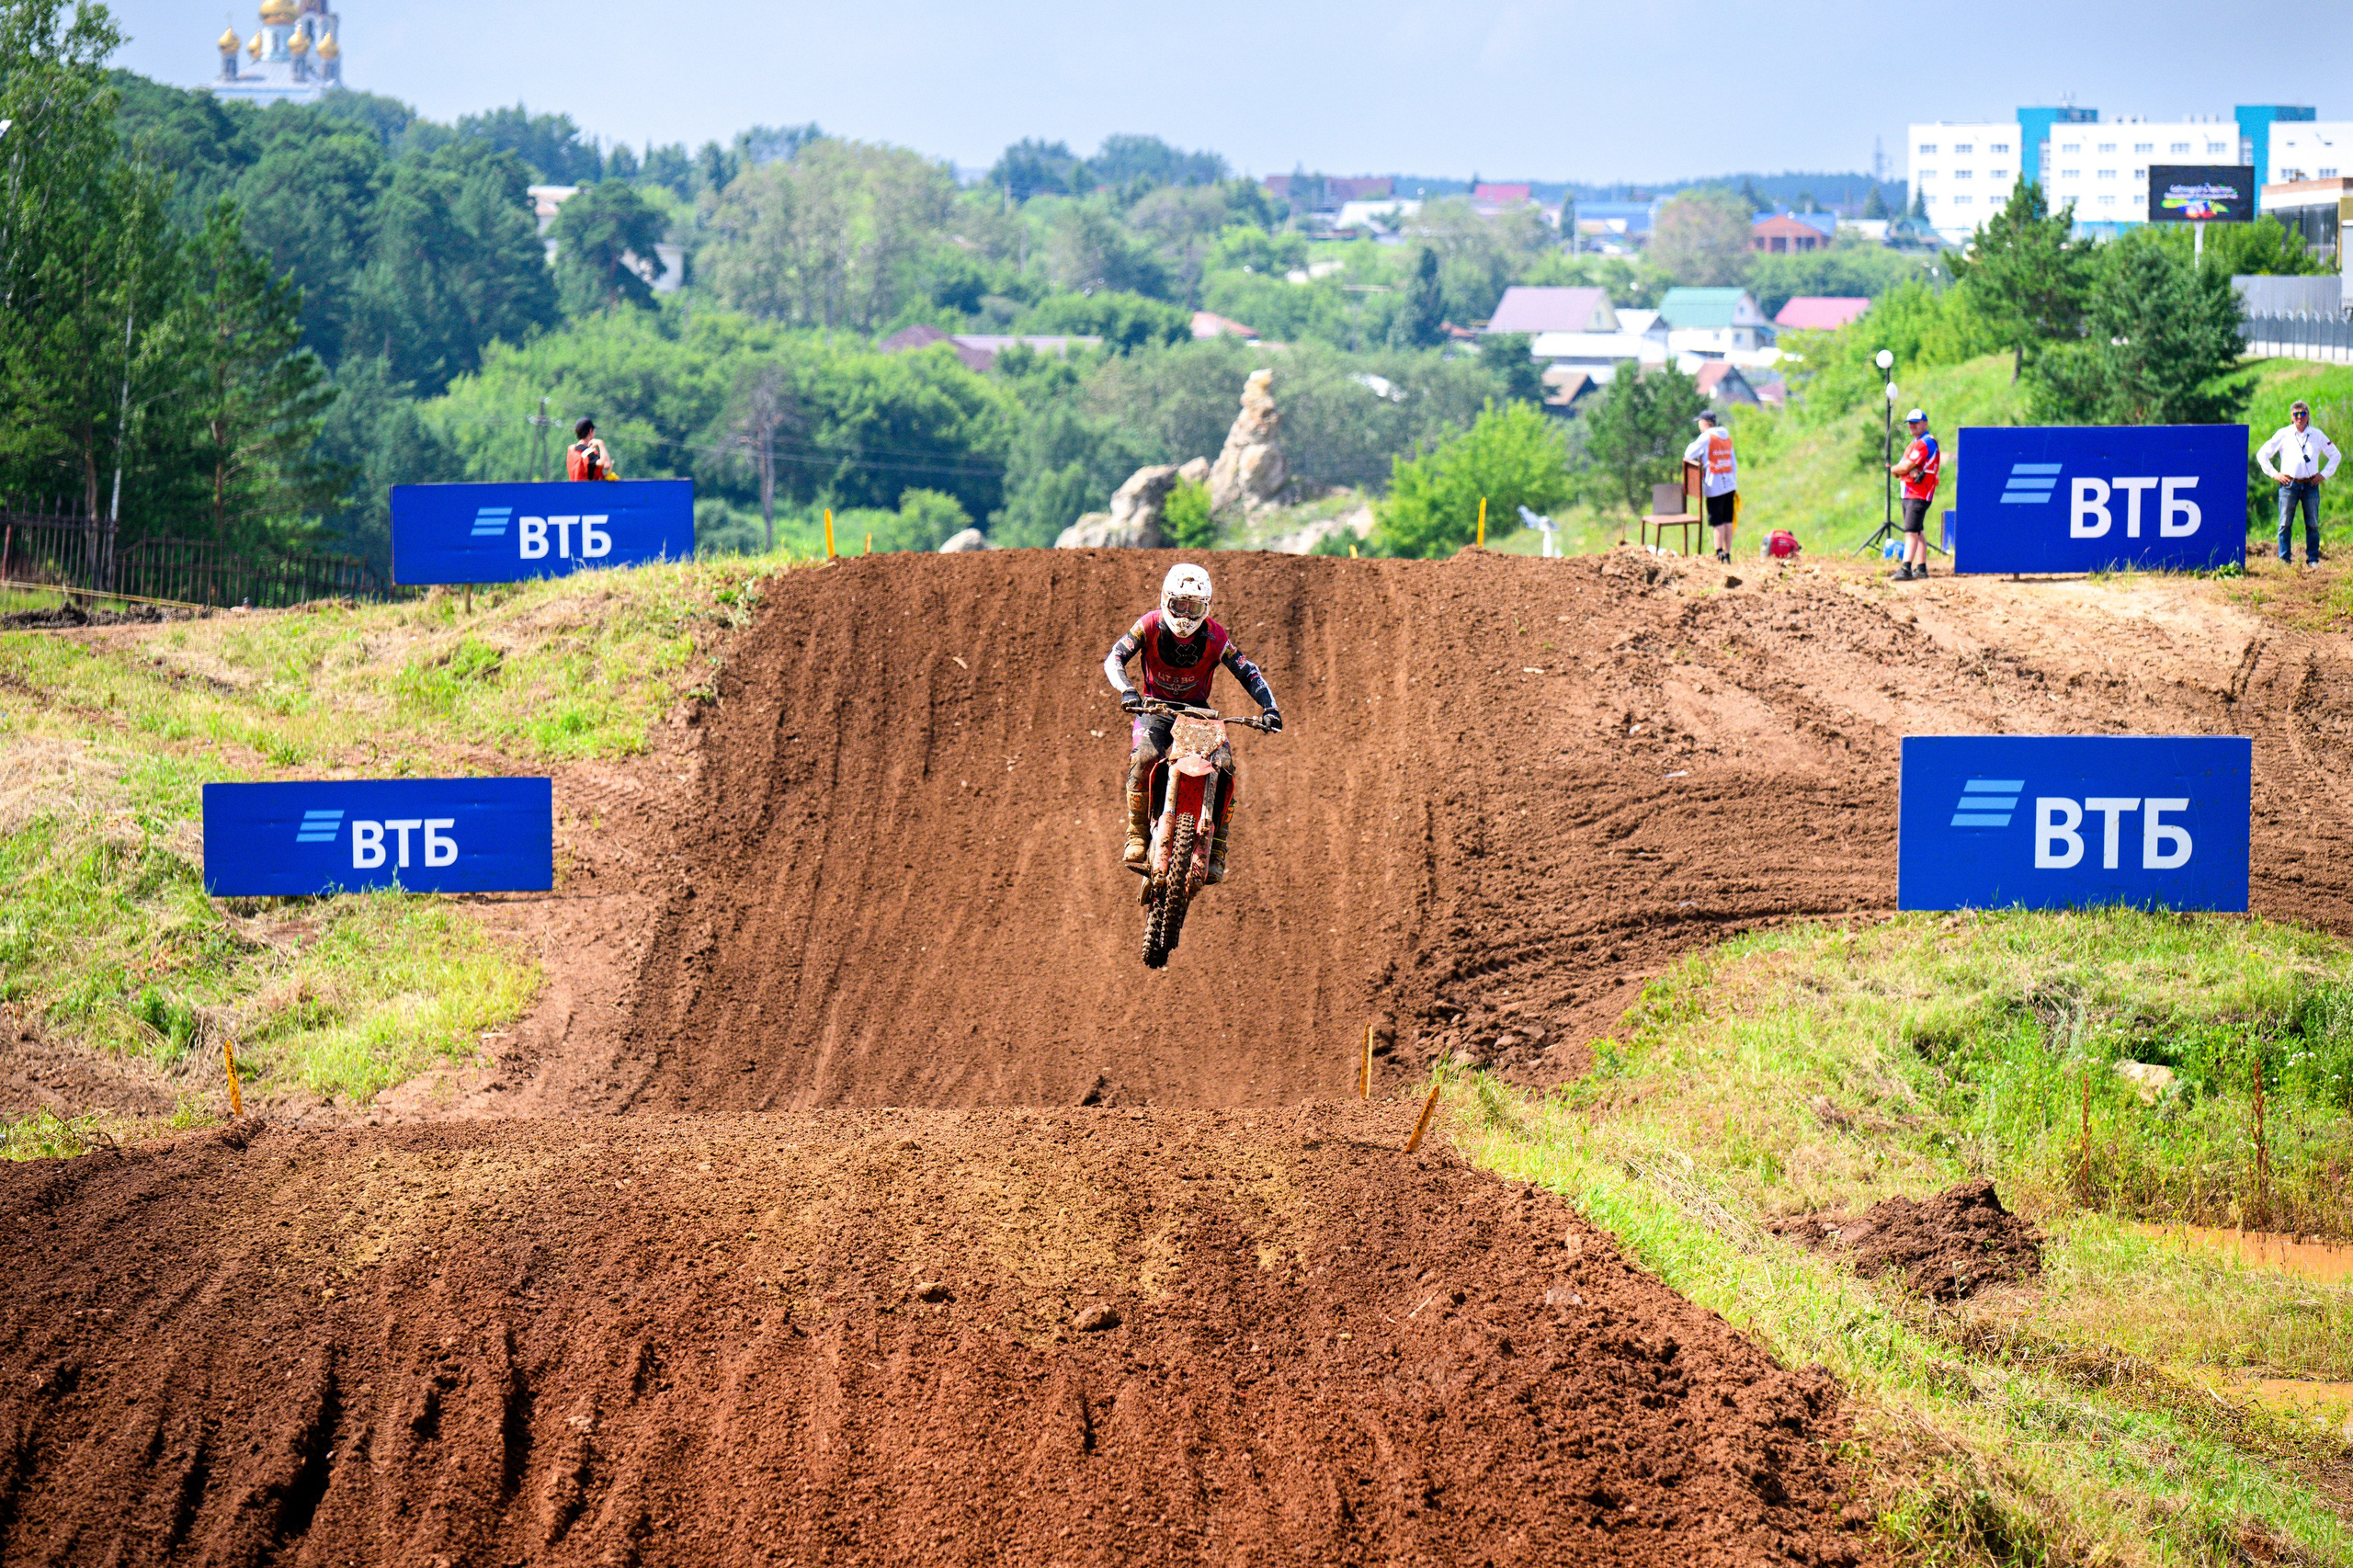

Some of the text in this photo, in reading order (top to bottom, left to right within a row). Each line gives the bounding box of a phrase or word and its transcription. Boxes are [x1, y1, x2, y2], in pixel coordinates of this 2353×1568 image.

[2070, 475, 2202, 539] ВТБ
[518, 514, 613, 559] ВТБ
[351, 817, 460, 869] ВТБ
[2034, 797, 2194, 869] ВТБ
